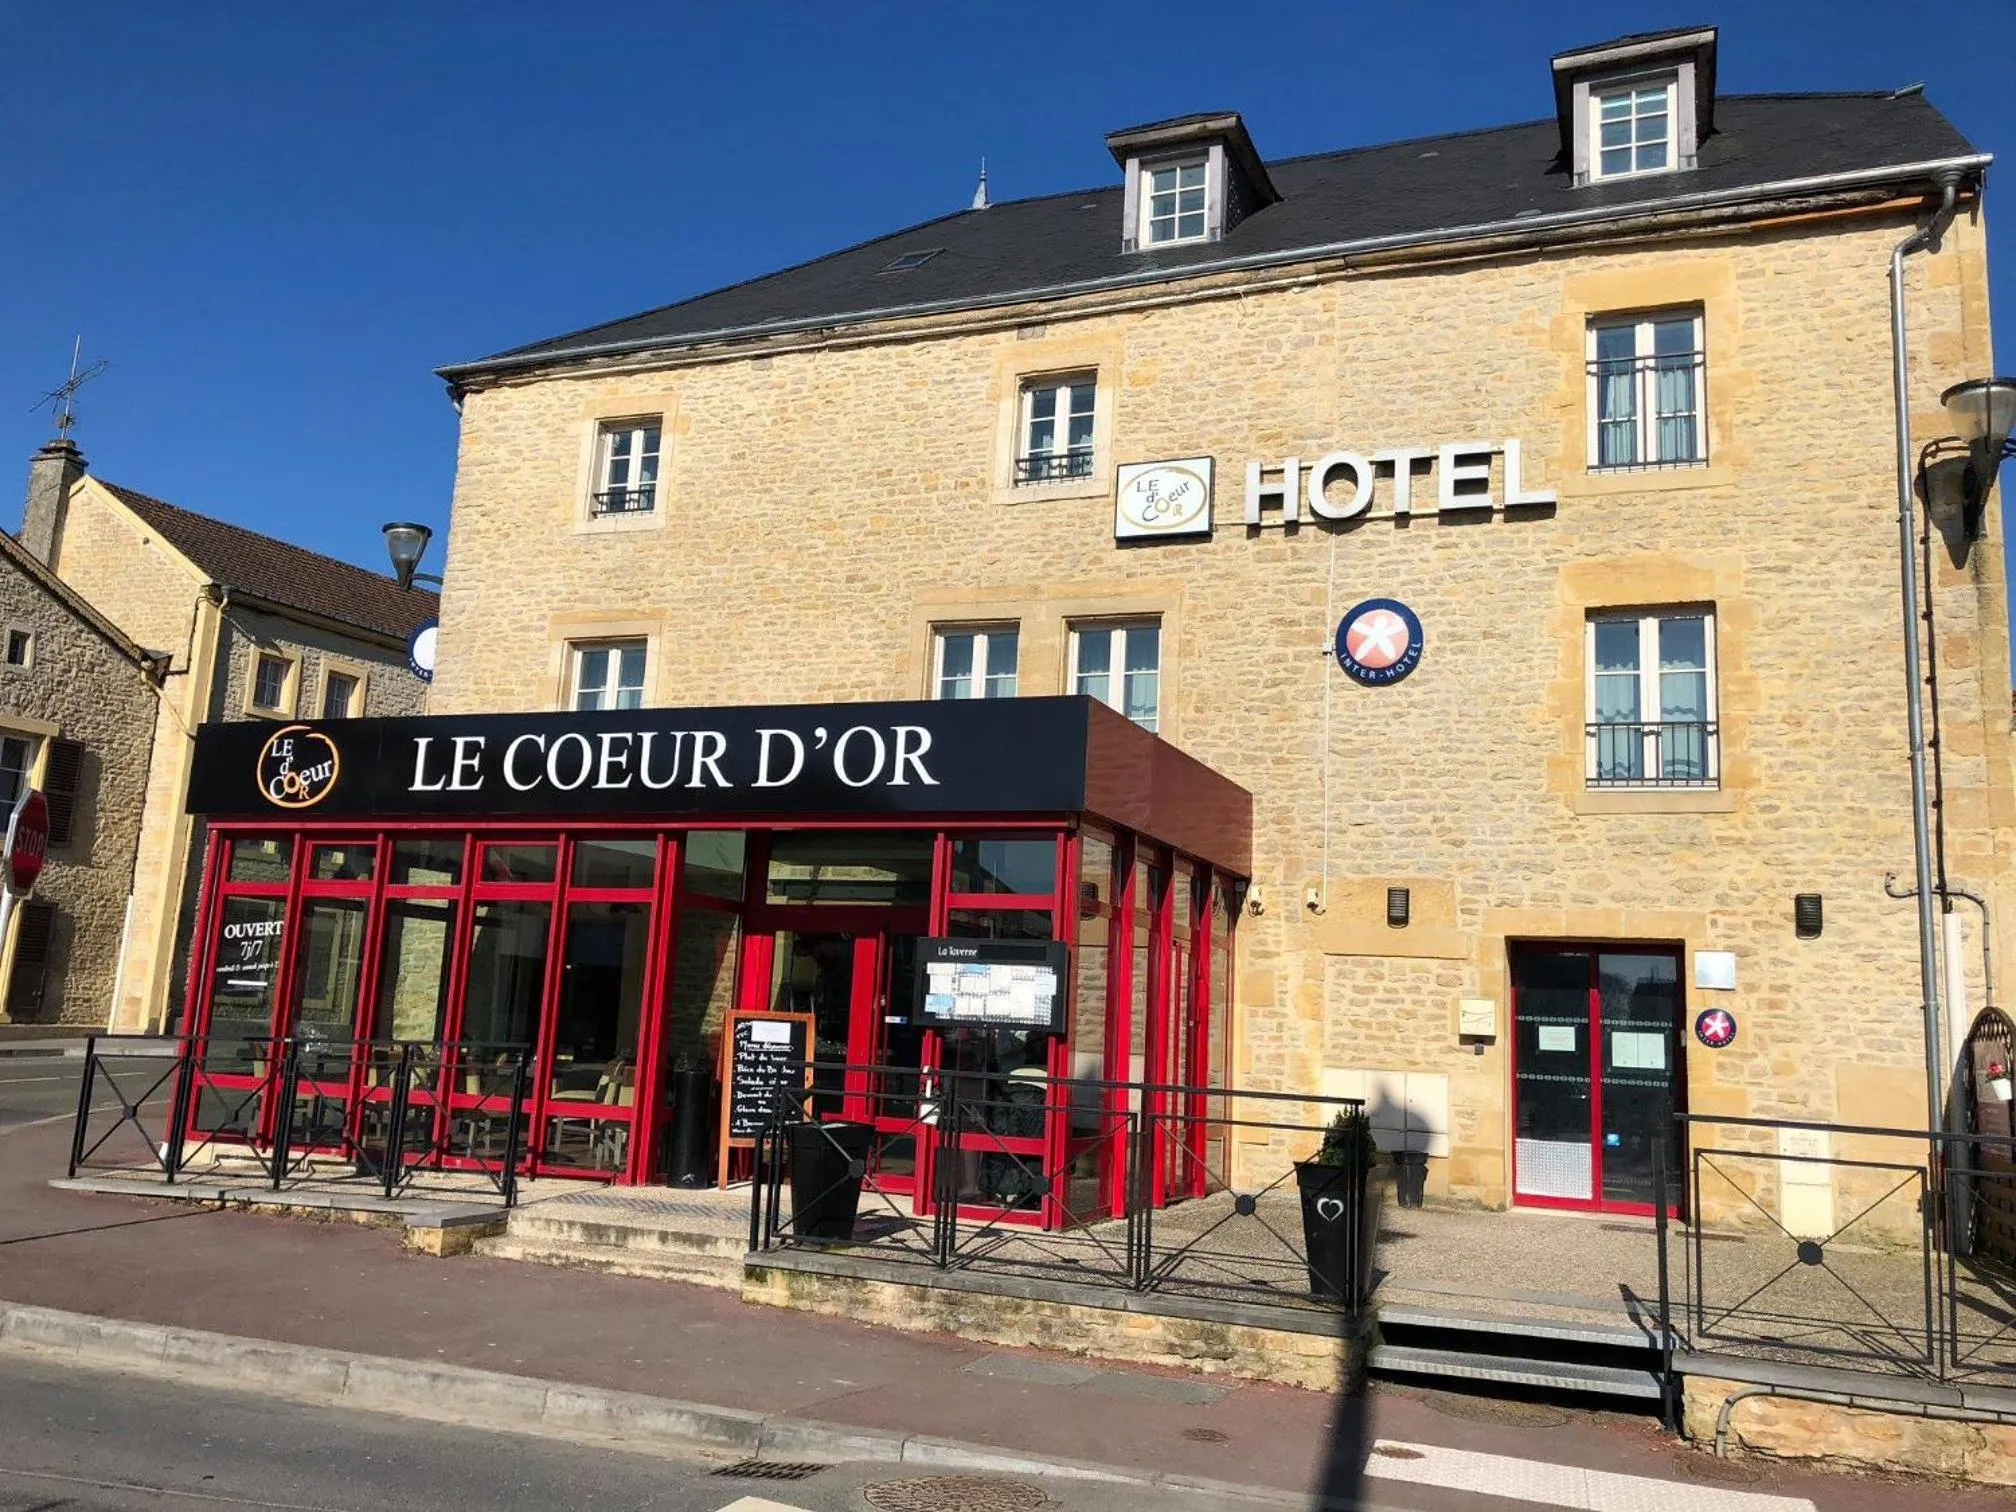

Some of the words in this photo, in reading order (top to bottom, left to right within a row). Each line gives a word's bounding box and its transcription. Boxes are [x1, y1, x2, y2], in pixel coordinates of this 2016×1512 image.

[1136, 479, 1160, 493] LE
[1245, 438, 1557, 524] HOTEL
[1340, 640, 1422, 680] INTER-HOTEL
[271, 738, 294, 757] LE
[407, 735, 486, 792] LE
[501, 730, 734, 791] COEUR
[19, 826, 44, 857] STOP
[224, 920, 285, 938] OUVERT
[937, 946, 948, 956] La
[949, 946, 977, 956] Taverne
